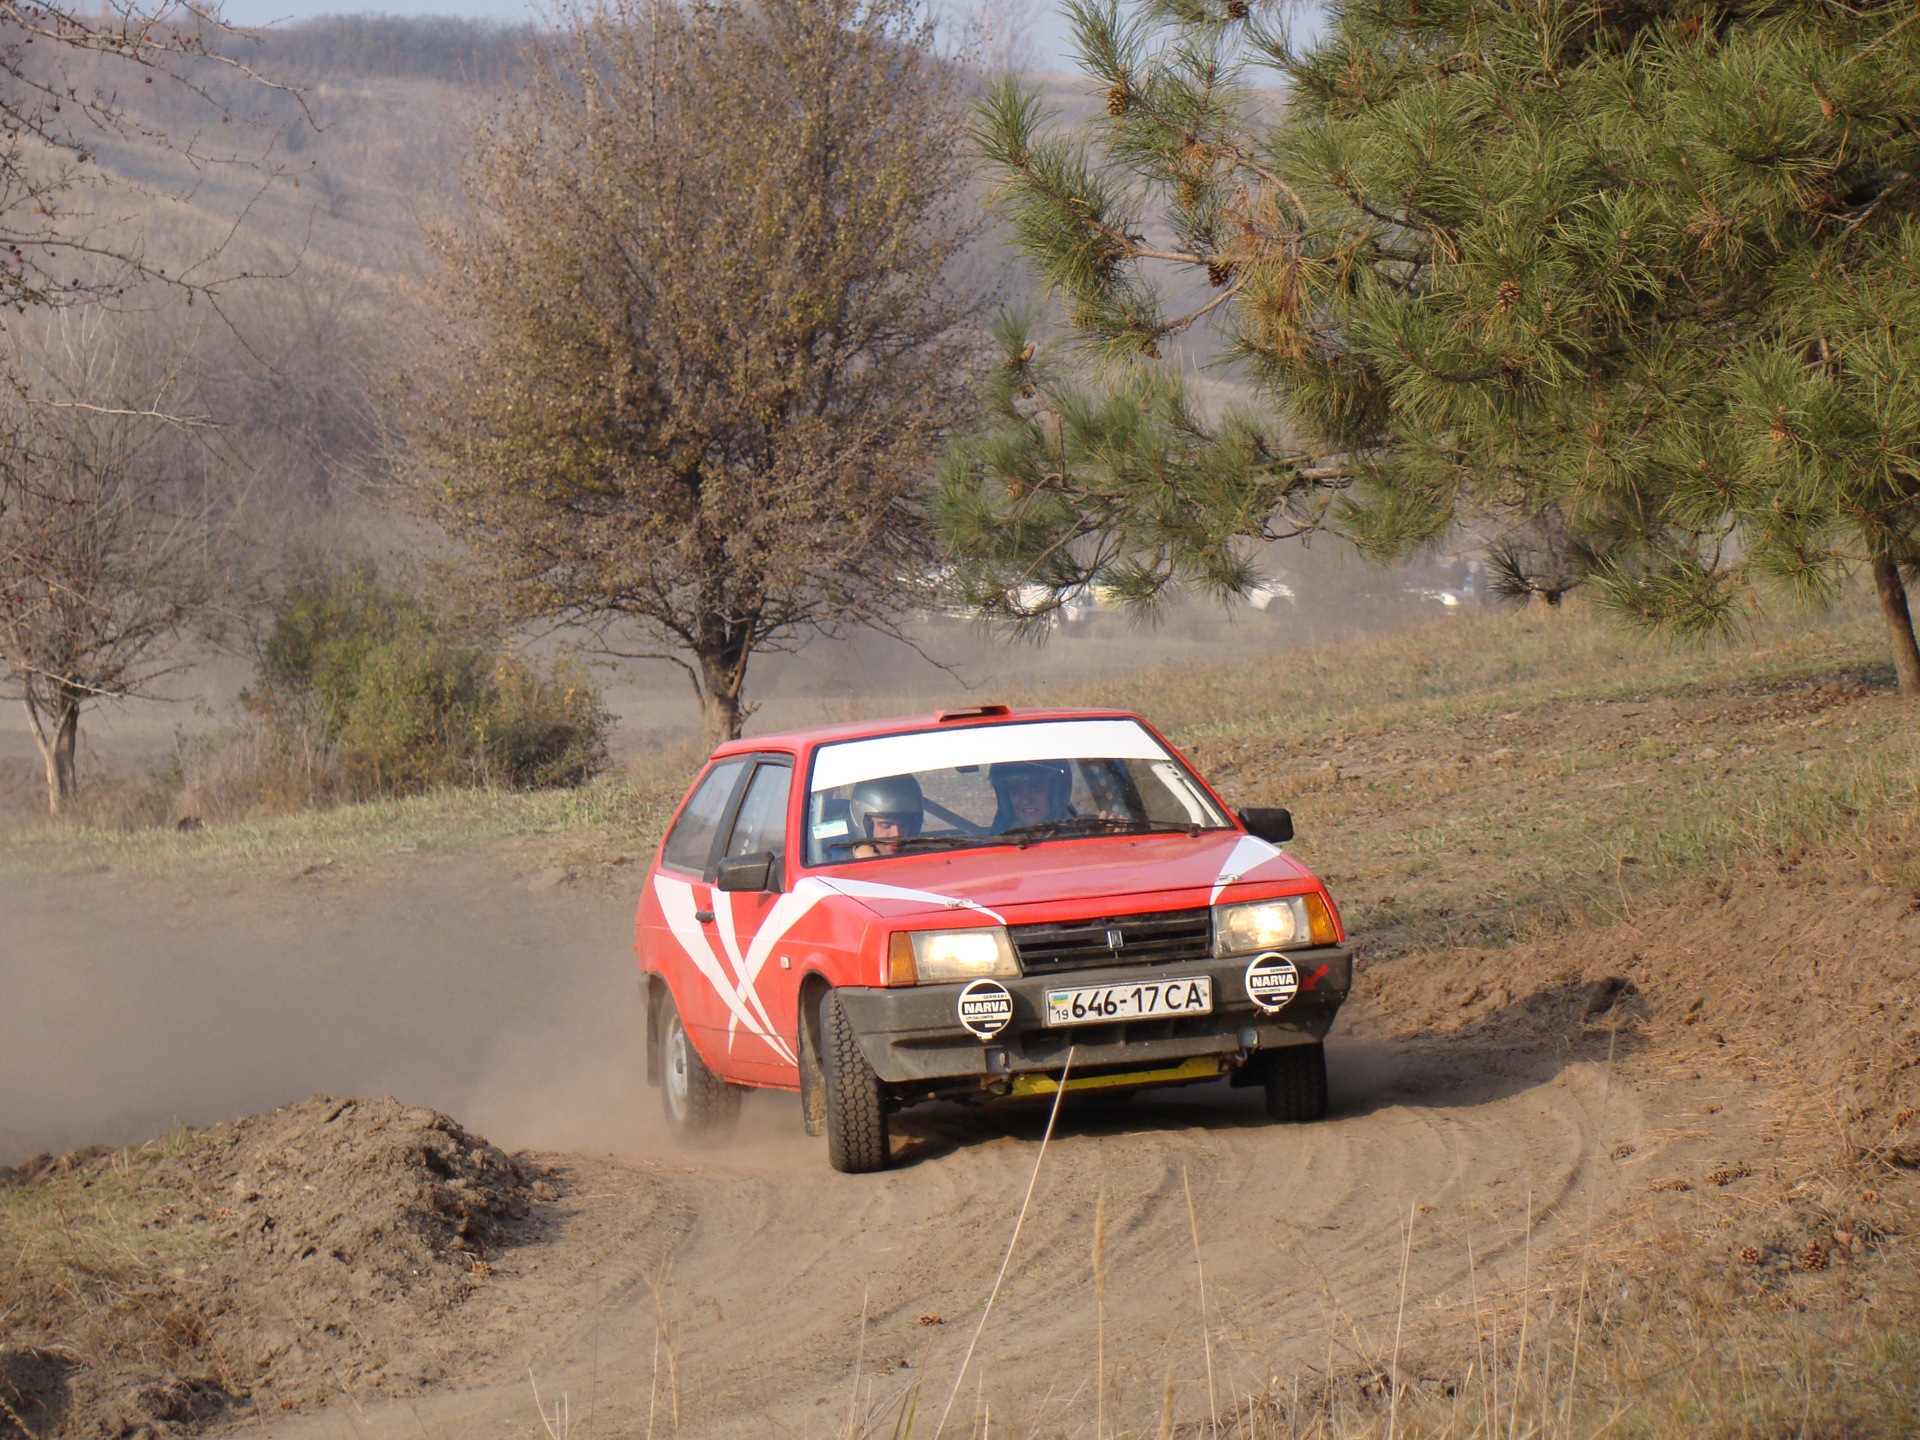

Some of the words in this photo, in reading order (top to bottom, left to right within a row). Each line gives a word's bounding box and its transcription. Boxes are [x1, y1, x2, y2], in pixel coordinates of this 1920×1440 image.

[1251, 974, 1295, 988] NARVA
[964, 1001, 1008, 1014] NARVA
[1055, 1009, 1068, 1021] 19
